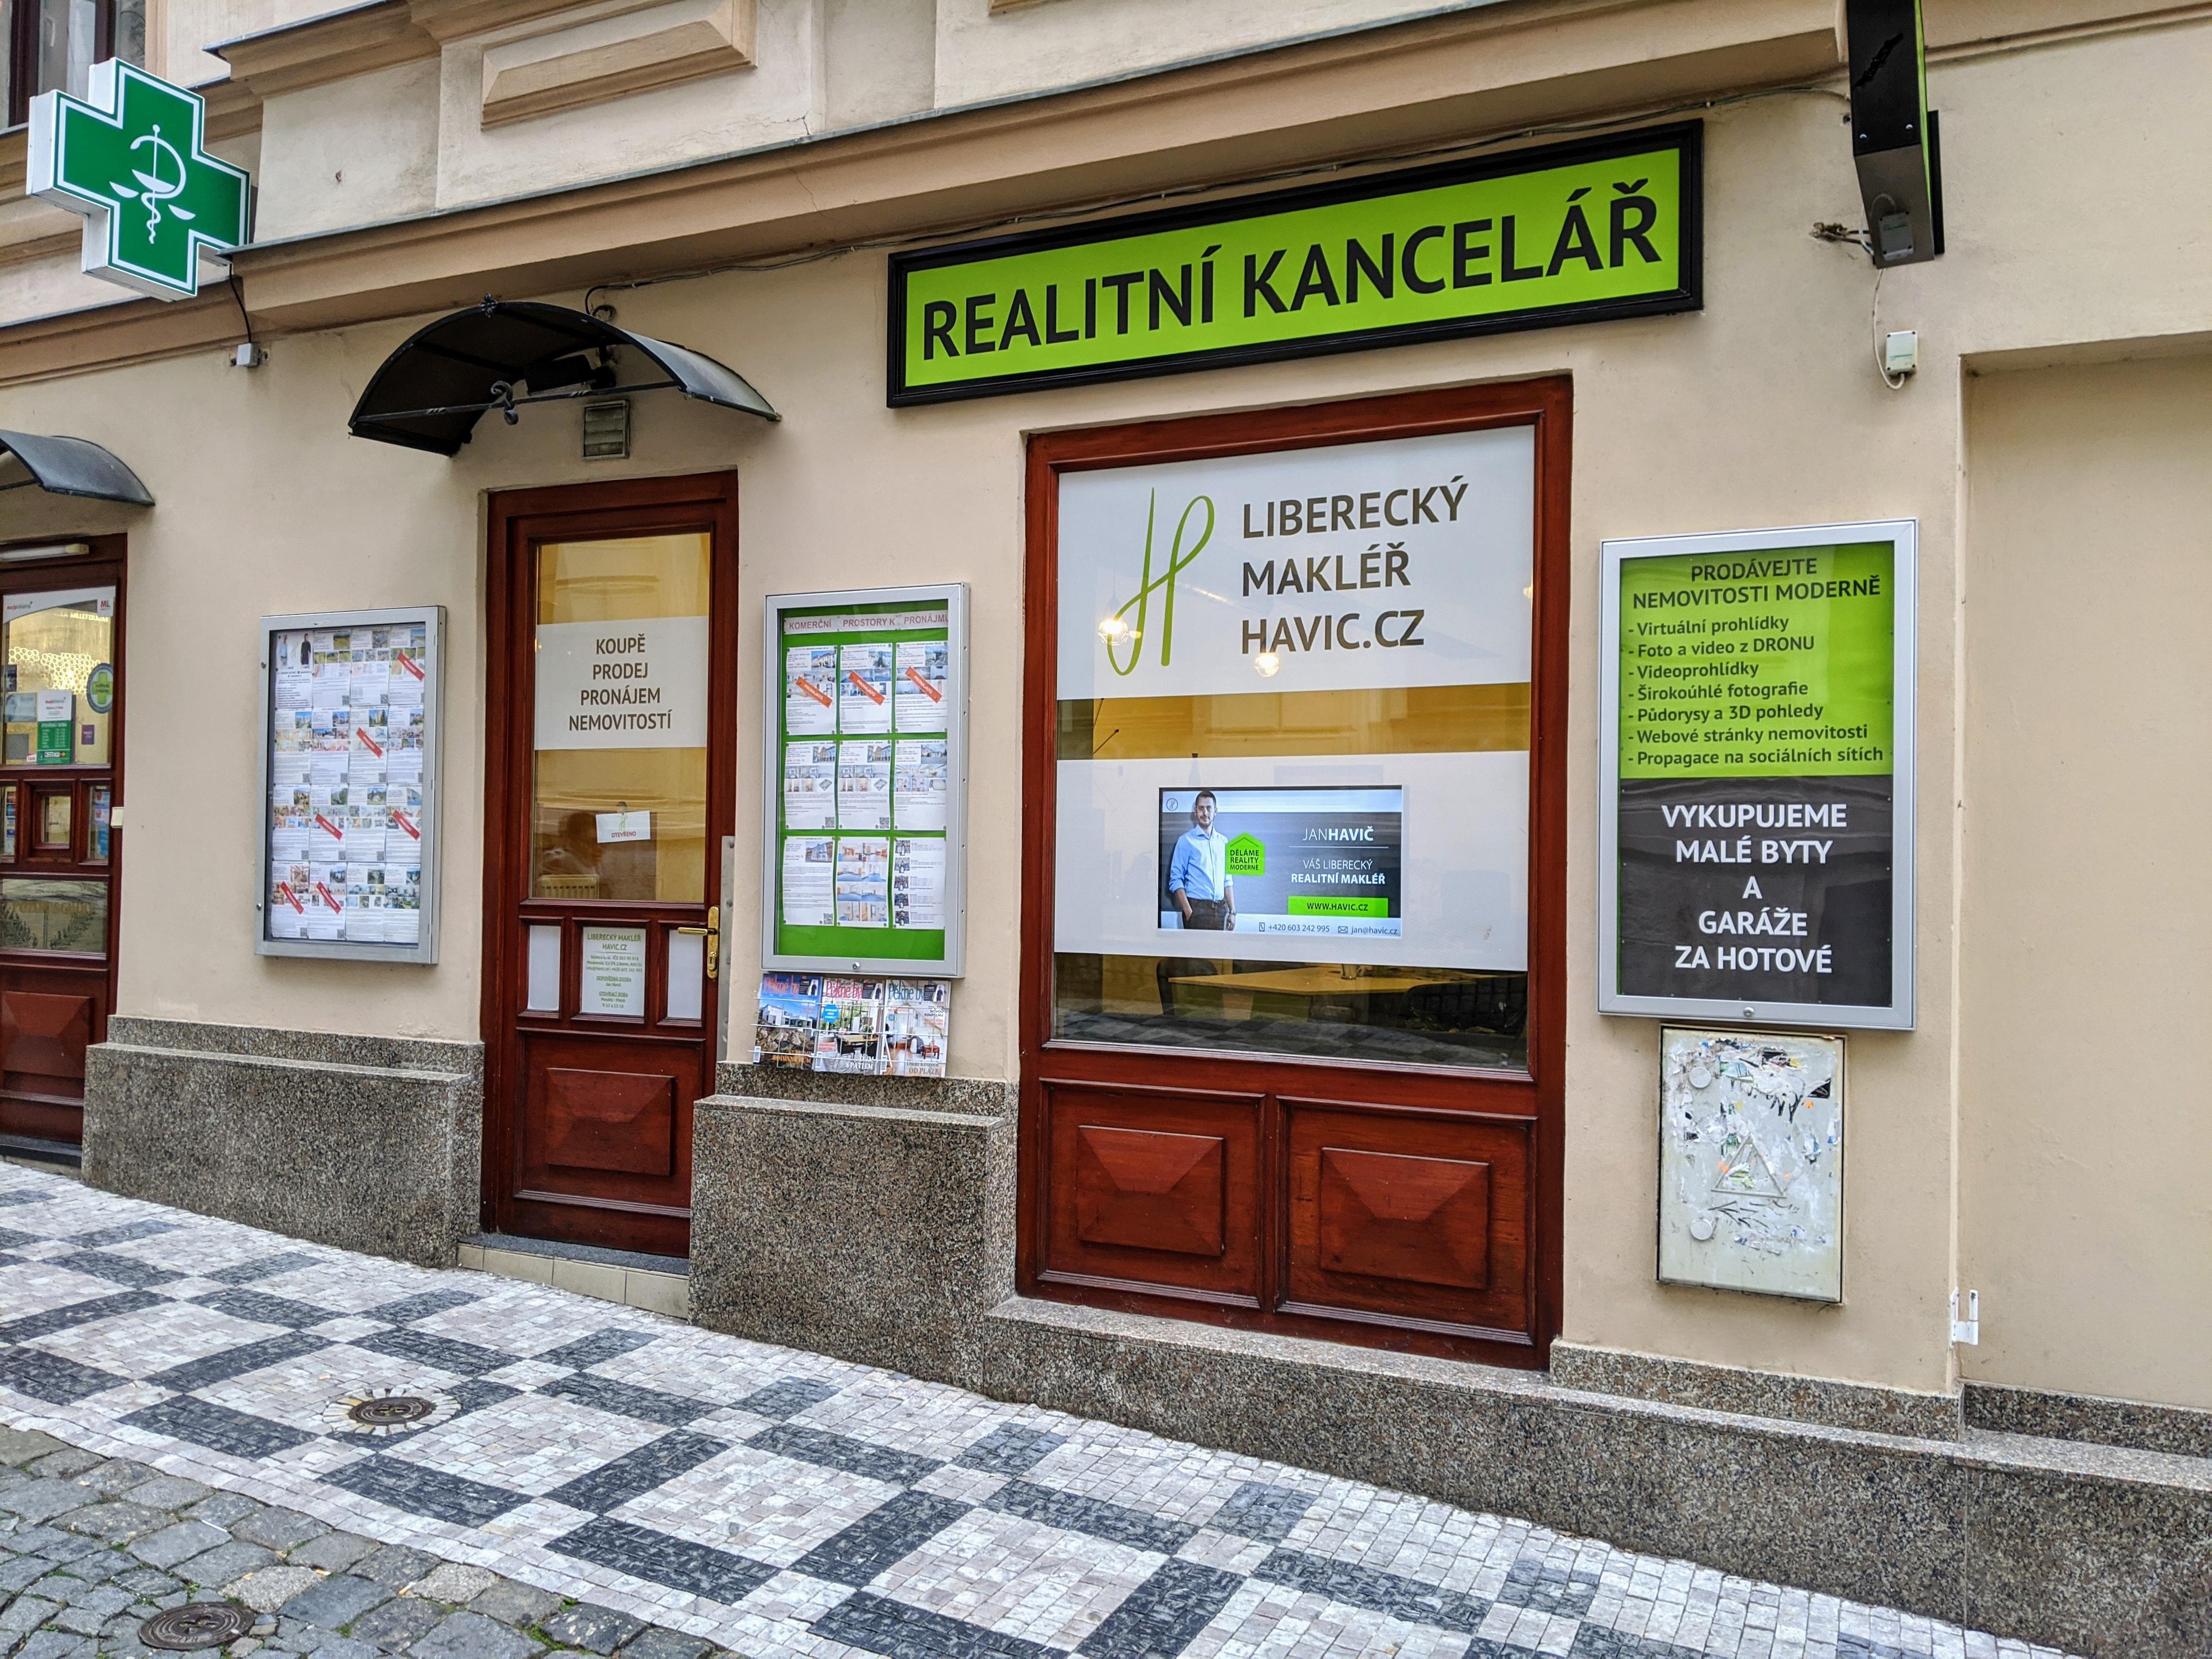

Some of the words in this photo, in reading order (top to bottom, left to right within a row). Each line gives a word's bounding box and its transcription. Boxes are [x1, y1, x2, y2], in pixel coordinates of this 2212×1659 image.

[923, 244, 1222, 361] REALITNÍ
[1243, 178, 1662, 318] KANCELÁŘ
[1243, 474, 1469, 539] LIBERECKÝ
[1242, 541, 1411, 597] MAKLÉŘ
[1691, 558, 1818, 582] PRODÁVEJTE
[1632, 585, 1768, 609] NEMOVITOSTI
[1775, 575, 1881, 601] MODERNĚ
[789, 619, 832, 630] KOMERČNÍ
[843, 618, 886, 628] PROSTORY
[889, 617, 895, 626] K
[1242, 609, 1425, 654] HAVIC.CZ
[1637, 619, 1707, 636] Virtuální
[1711, 616, 1790, 635] prohlídky
[596, 633, 646, 655] KOUPĚ
[1637, 644, 1673, 658] Foto
[1677, 645, 1687, 656] a
[1691, 641, 1735, 655] video
[1740, 643, 1749, 653] z
[1753, 636, 1815, 653] DRONU
[592, 662, 648, 680] PRODEJ
[1637, 661, 1759, 680] Videoprohlídky
[580, 685, 661, 706] PRONÁJEM
[1637, 684, 1723, 701] Širokoúhlé
[1727, 681, 1809, 701] fotografie
[568, 709, 673, 731] NEMOVITOSTÍ
[1637, 707, 1710, 724] Půdorysy
[1714, 710, 1723, 720] a
[1729, 706, 1751, 720] 3D
[1756, 703, 1824, 722] pohledy
[1637, 729, 1699, 743] Webové
[1703, 727, 1764, 744] stránky
[1768, 724, 1868, 741] nemovitosti
[1637, 752, 1719, 768] Propagace
[1724, 753, 1744, 764] na
[1749, 748, 1832, 763] sociálních
[1837, 747, 1884, 761] sítích
[1661, 804, 1848, 828] VYKUPUJEME
[1230, 848, 1259, 857] DĚLÁME
[1676, 835, 1752, 863] MALÉ
[1761, 840, 1833, 864] BYTY
[1303, 858, 1322, 869] VÁŠ
[1323, 858, 1373, 870] LIBERECKÝ
[1291, 872, 1339, 884] REALITNÍ
[1340, 873, 1386, 885] MAKLÉŘ
[1742, 875, 1763, 899] A
[1307, 902, 1369, 911] WWW.HAVIC.CZ
[1350, 926, 1398, 936] jan@havic.cz
[1698, 907, 1808, 936] GARÁŽE
[618, 933, 641, 942] MAKLÉŘ
[1674, 945, 1711, 969] ZA
[1718, 944, 1833, 973] HOTOVÉ
